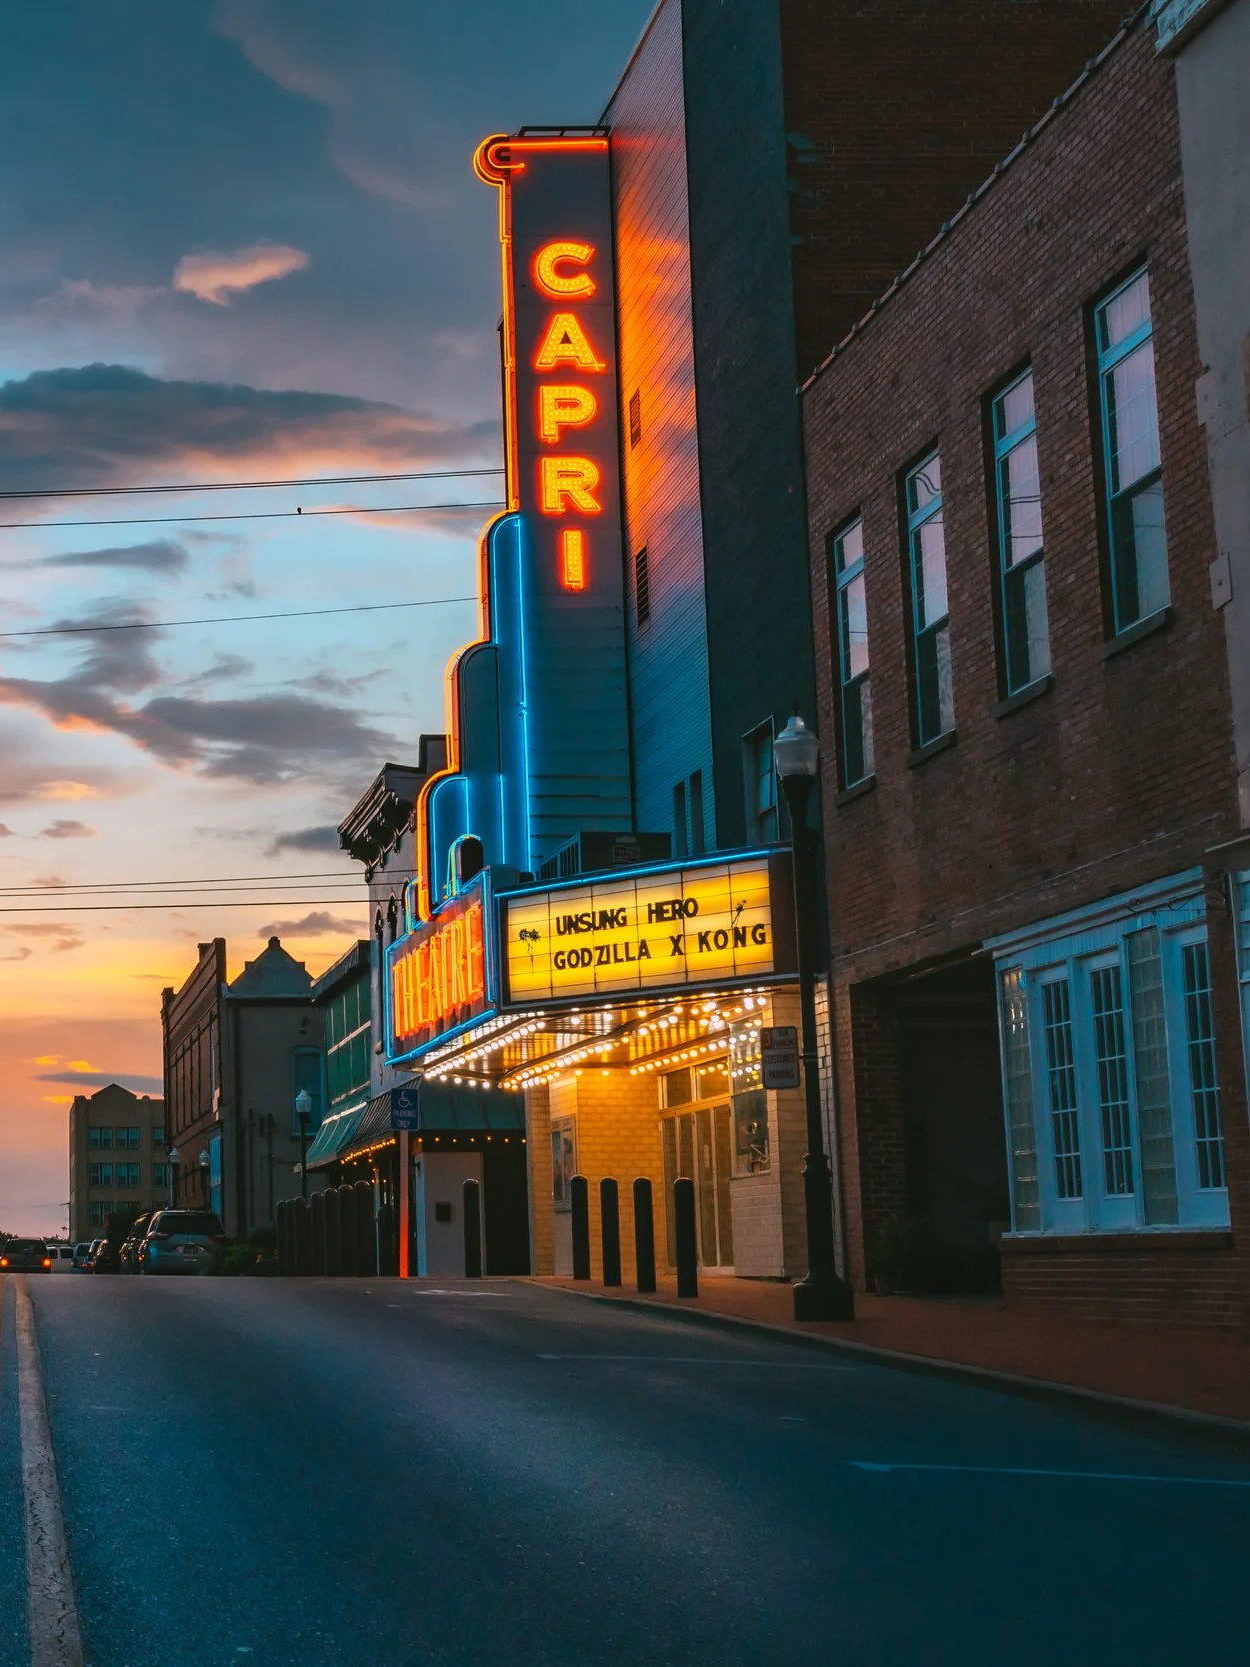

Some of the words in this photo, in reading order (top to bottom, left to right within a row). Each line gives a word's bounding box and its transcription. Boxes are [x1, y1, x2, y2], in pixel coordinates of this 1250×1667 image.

[535, 241, 603, 589] CAPRI
[556, 907, 627, 936] UNSUNG
[647, 897, 699, 924] HERO
[553, 938, 651, 970] GODZILLA
[669, 934, 684, 957] X
[698, 923, 767, 953] KONG
[392, 904, 485, 1038] THEATRE
[392, 1109, 416, 1118] PARKING
